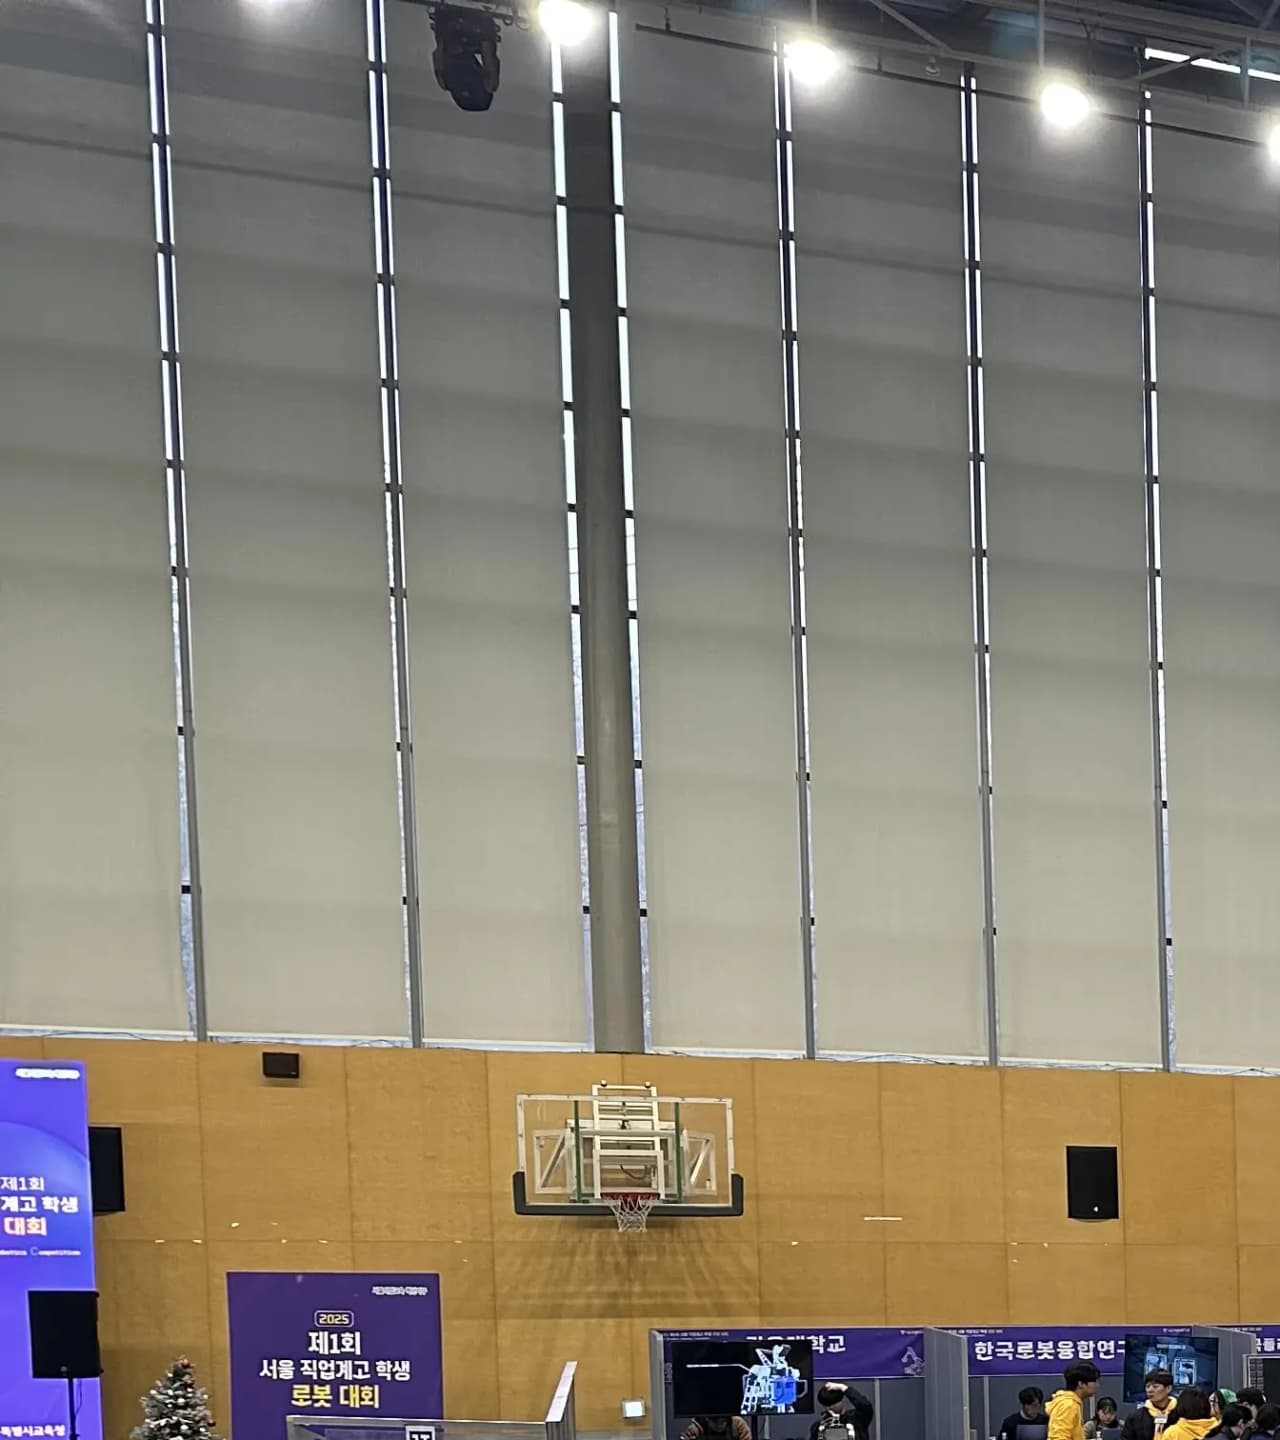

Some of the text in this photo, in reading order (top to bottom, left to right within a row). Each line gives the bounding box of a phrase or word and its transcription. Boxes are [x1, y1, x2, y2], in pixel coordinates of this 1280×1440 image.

[41, 1196, 79, 1213] 학생
[3, 1217, 47, 1236] 대회
[318, 1313, 350, 1325] 2025
[307, 1331, 361, 1356] 제1회
[259, 1359, 411, 1382] 서울 직업계고 학생
[291, 1384, 380, 1409] 로봇 대회
